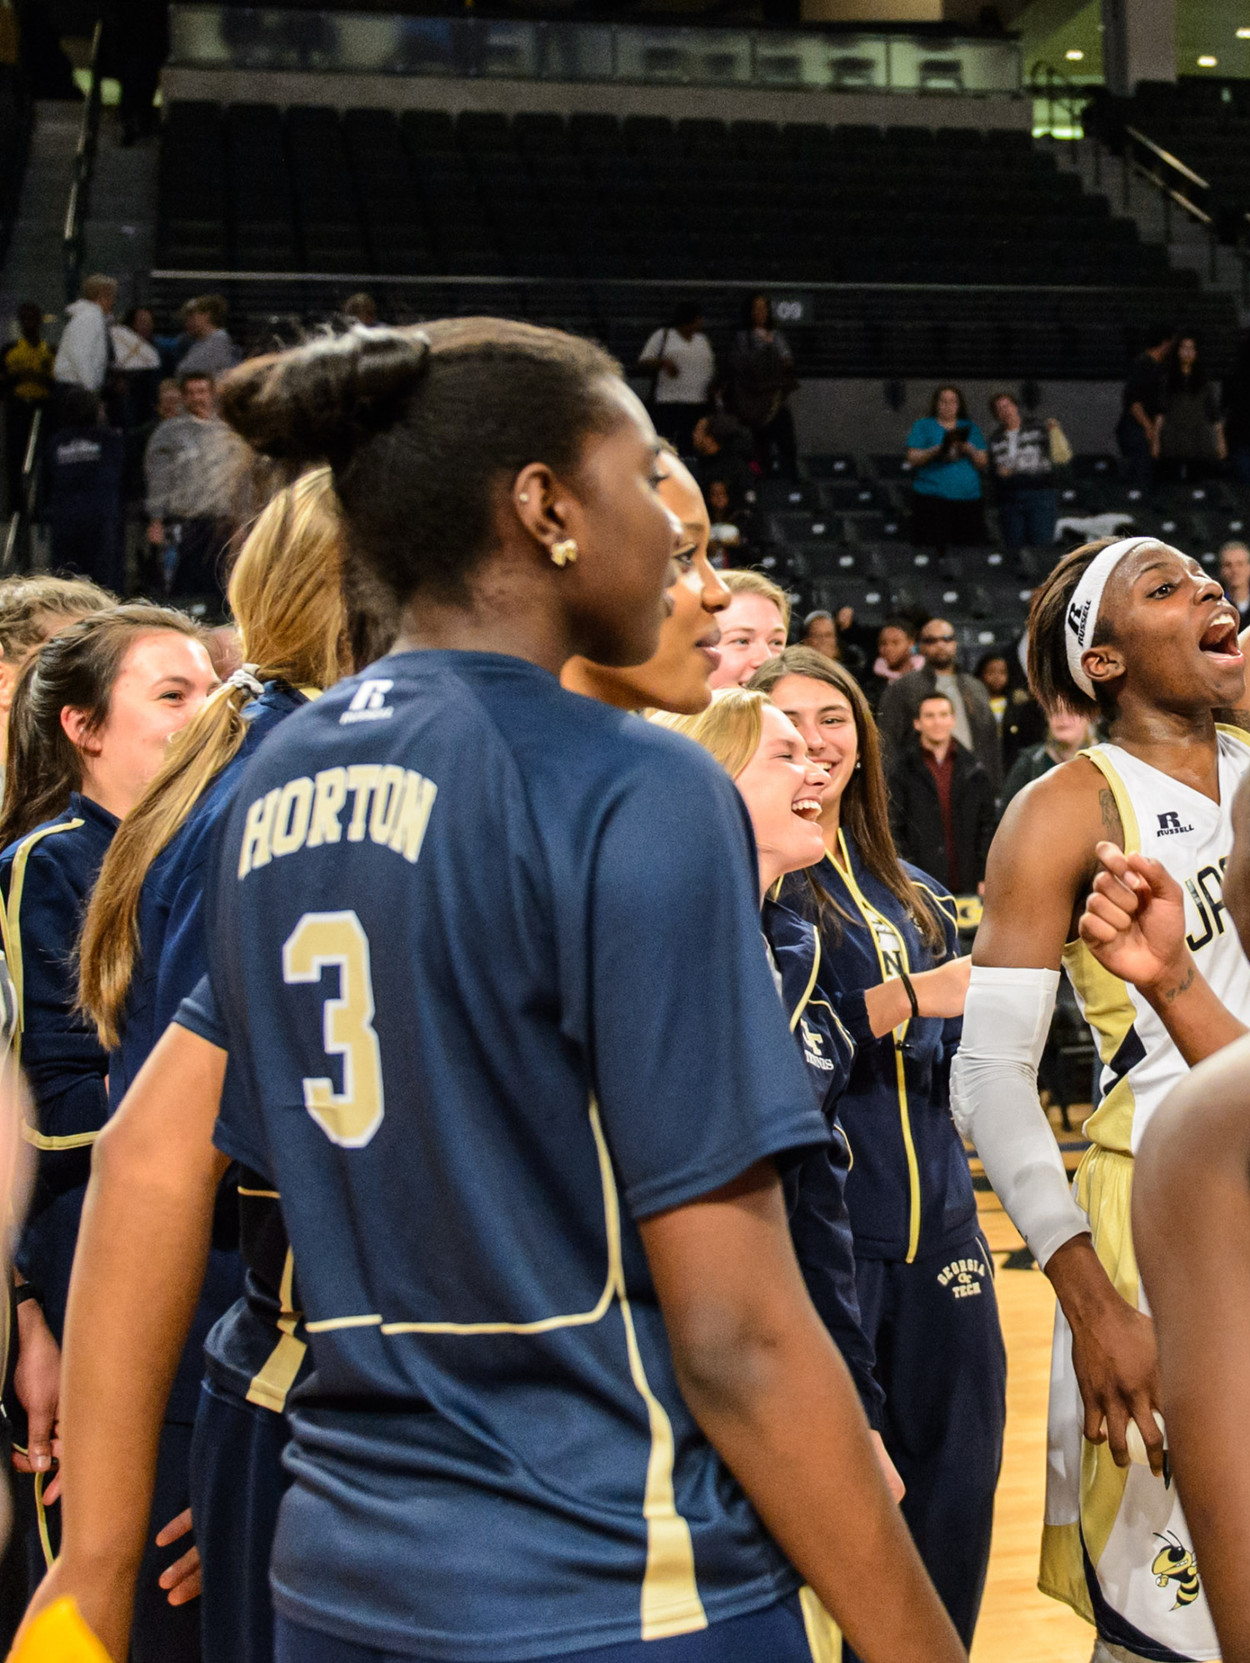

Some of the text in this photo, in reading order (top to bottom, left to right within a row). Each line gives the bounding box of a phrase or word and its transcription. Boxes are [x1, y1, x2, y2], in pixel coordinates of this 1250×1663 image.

[1077, 600, 1092, 647] RUSSELL
[238, 763, 438, 880] HORTON
[1156, 824, 1195, 838] RUSSELL
[282, 909, 385, 1147] 3
[951, 1281, 982, 1299] TECH
